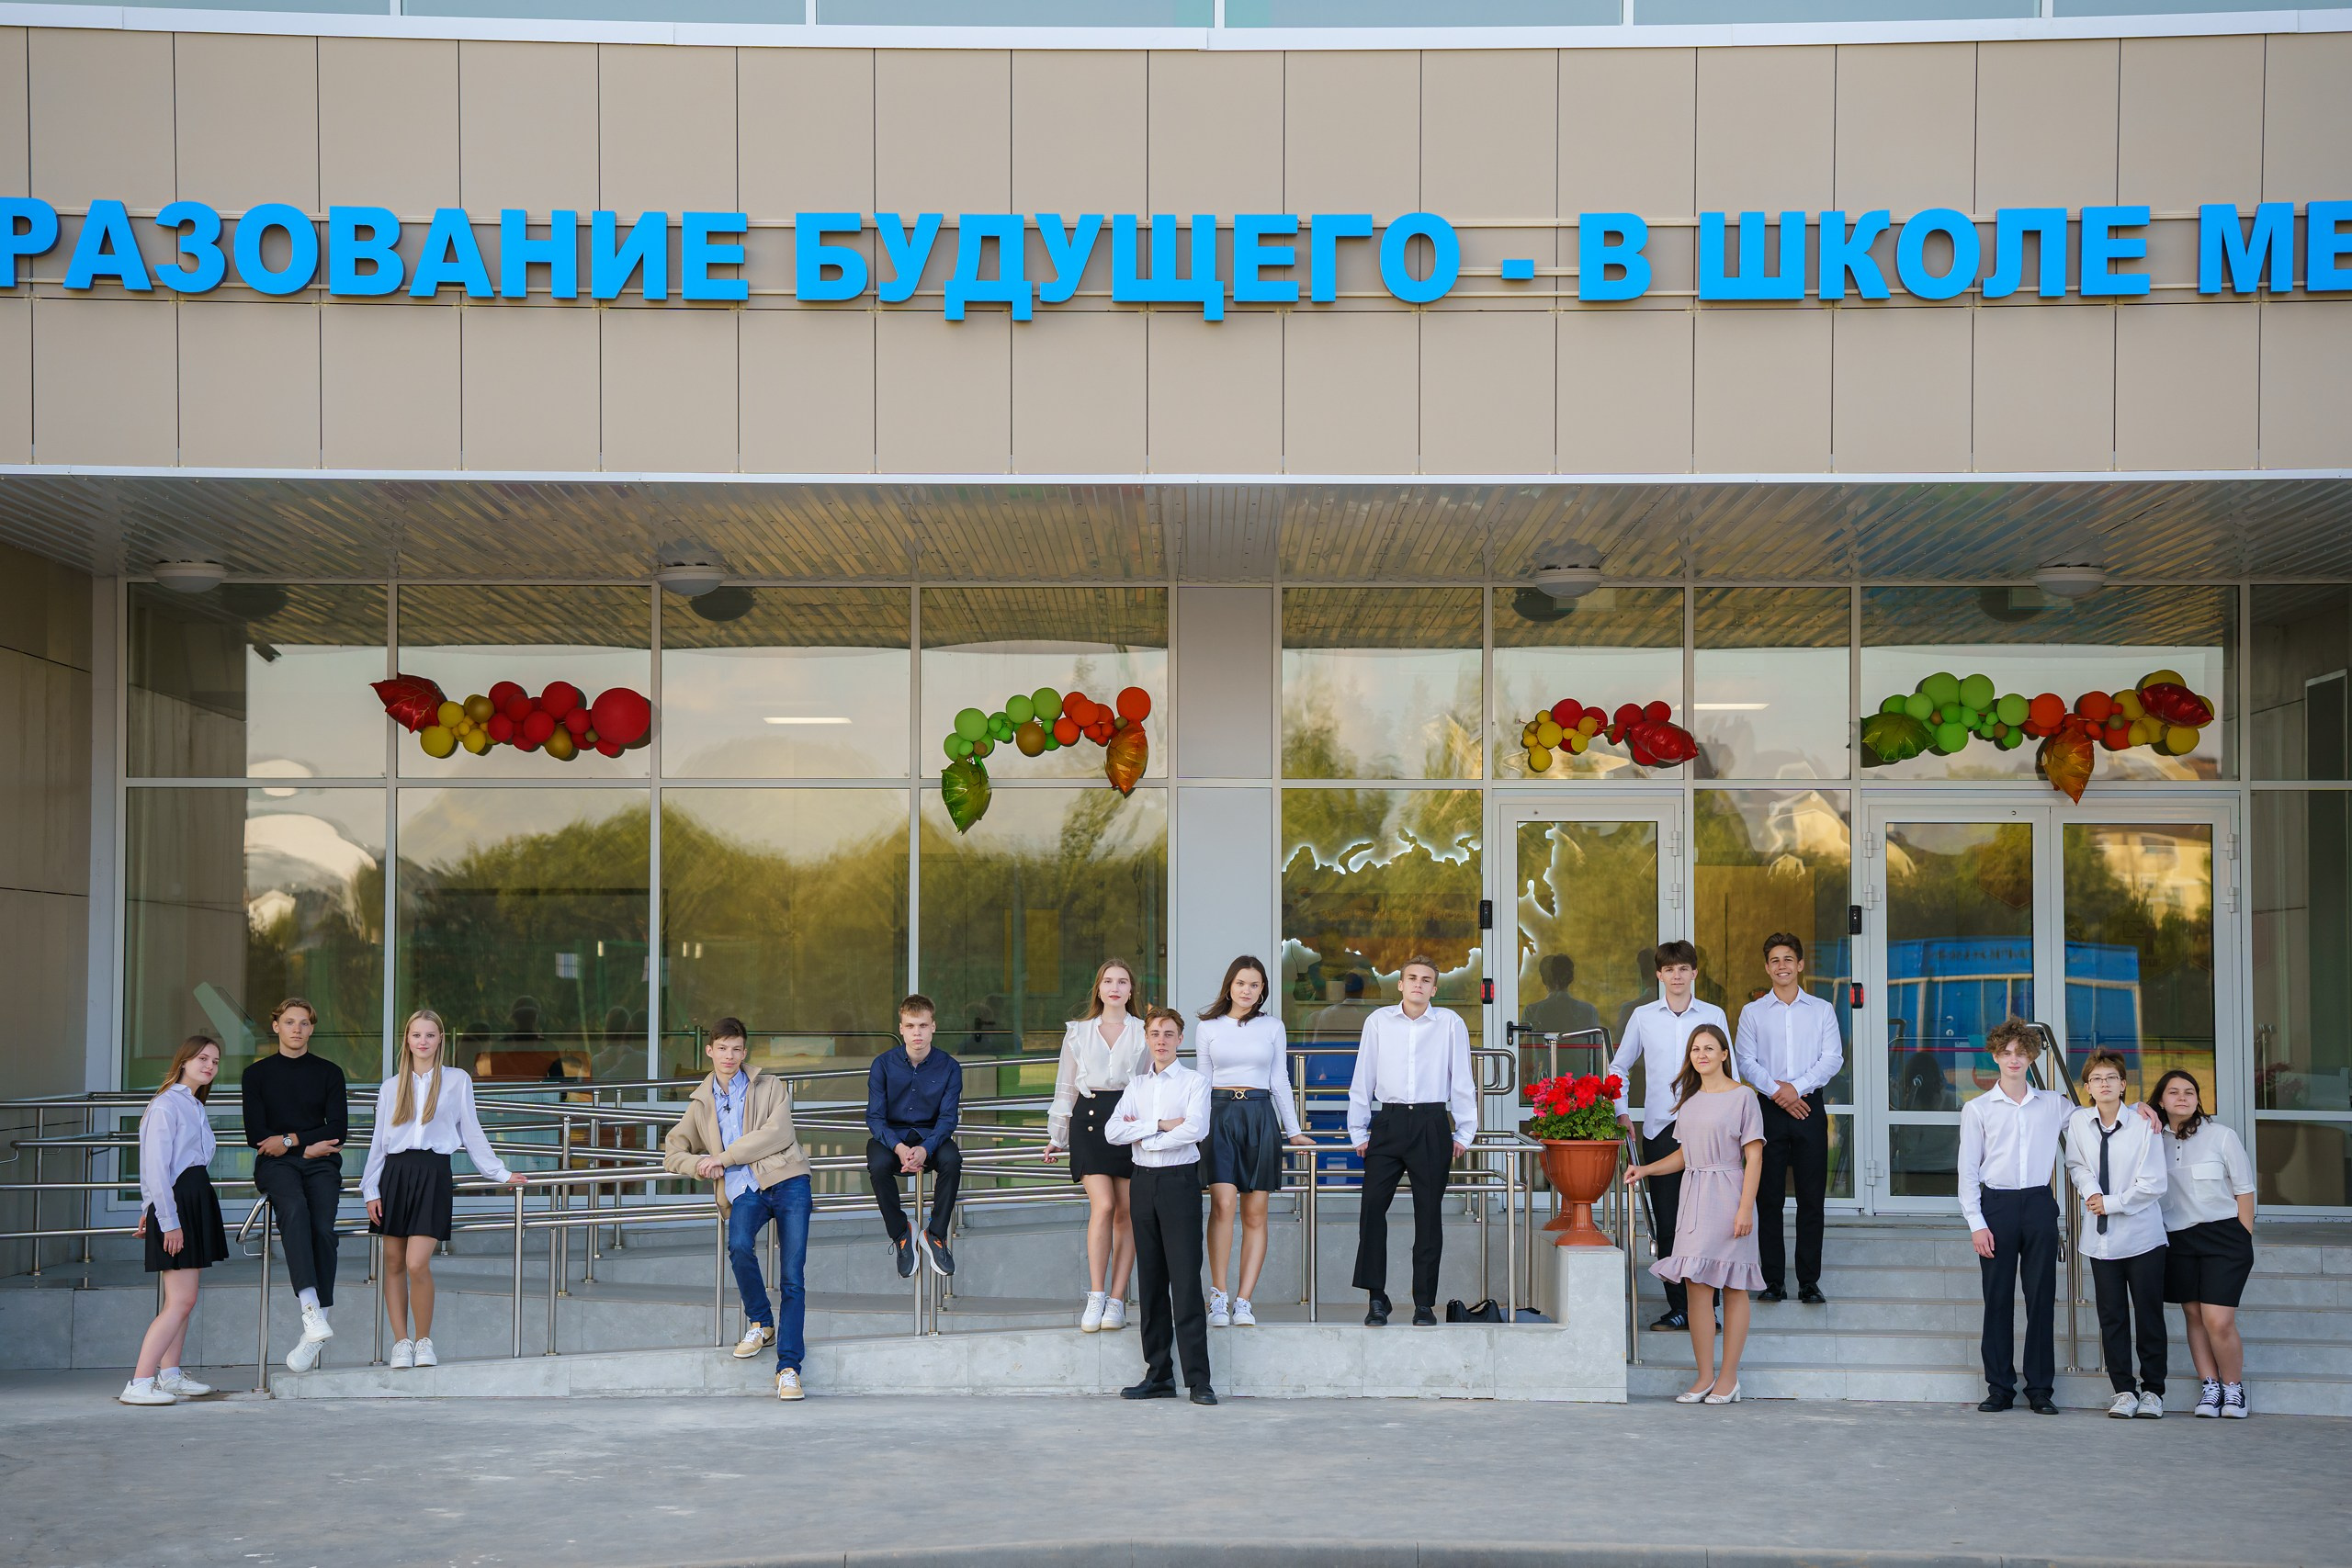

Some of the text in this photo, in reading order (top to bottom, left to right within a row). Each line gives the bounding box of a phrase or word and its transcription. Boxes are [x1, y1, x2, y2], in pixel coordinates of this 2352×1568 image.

[0, 196, 750, 302] РАЗОВАНИЕ
[795, 211, 1461, 321] БУДУЩЕГО
[1577, 212, 1653, 302] В
[1698, 205, 2151, 302] ШКОЛЕ
[2197, 199, 2352, 295] МЕ
